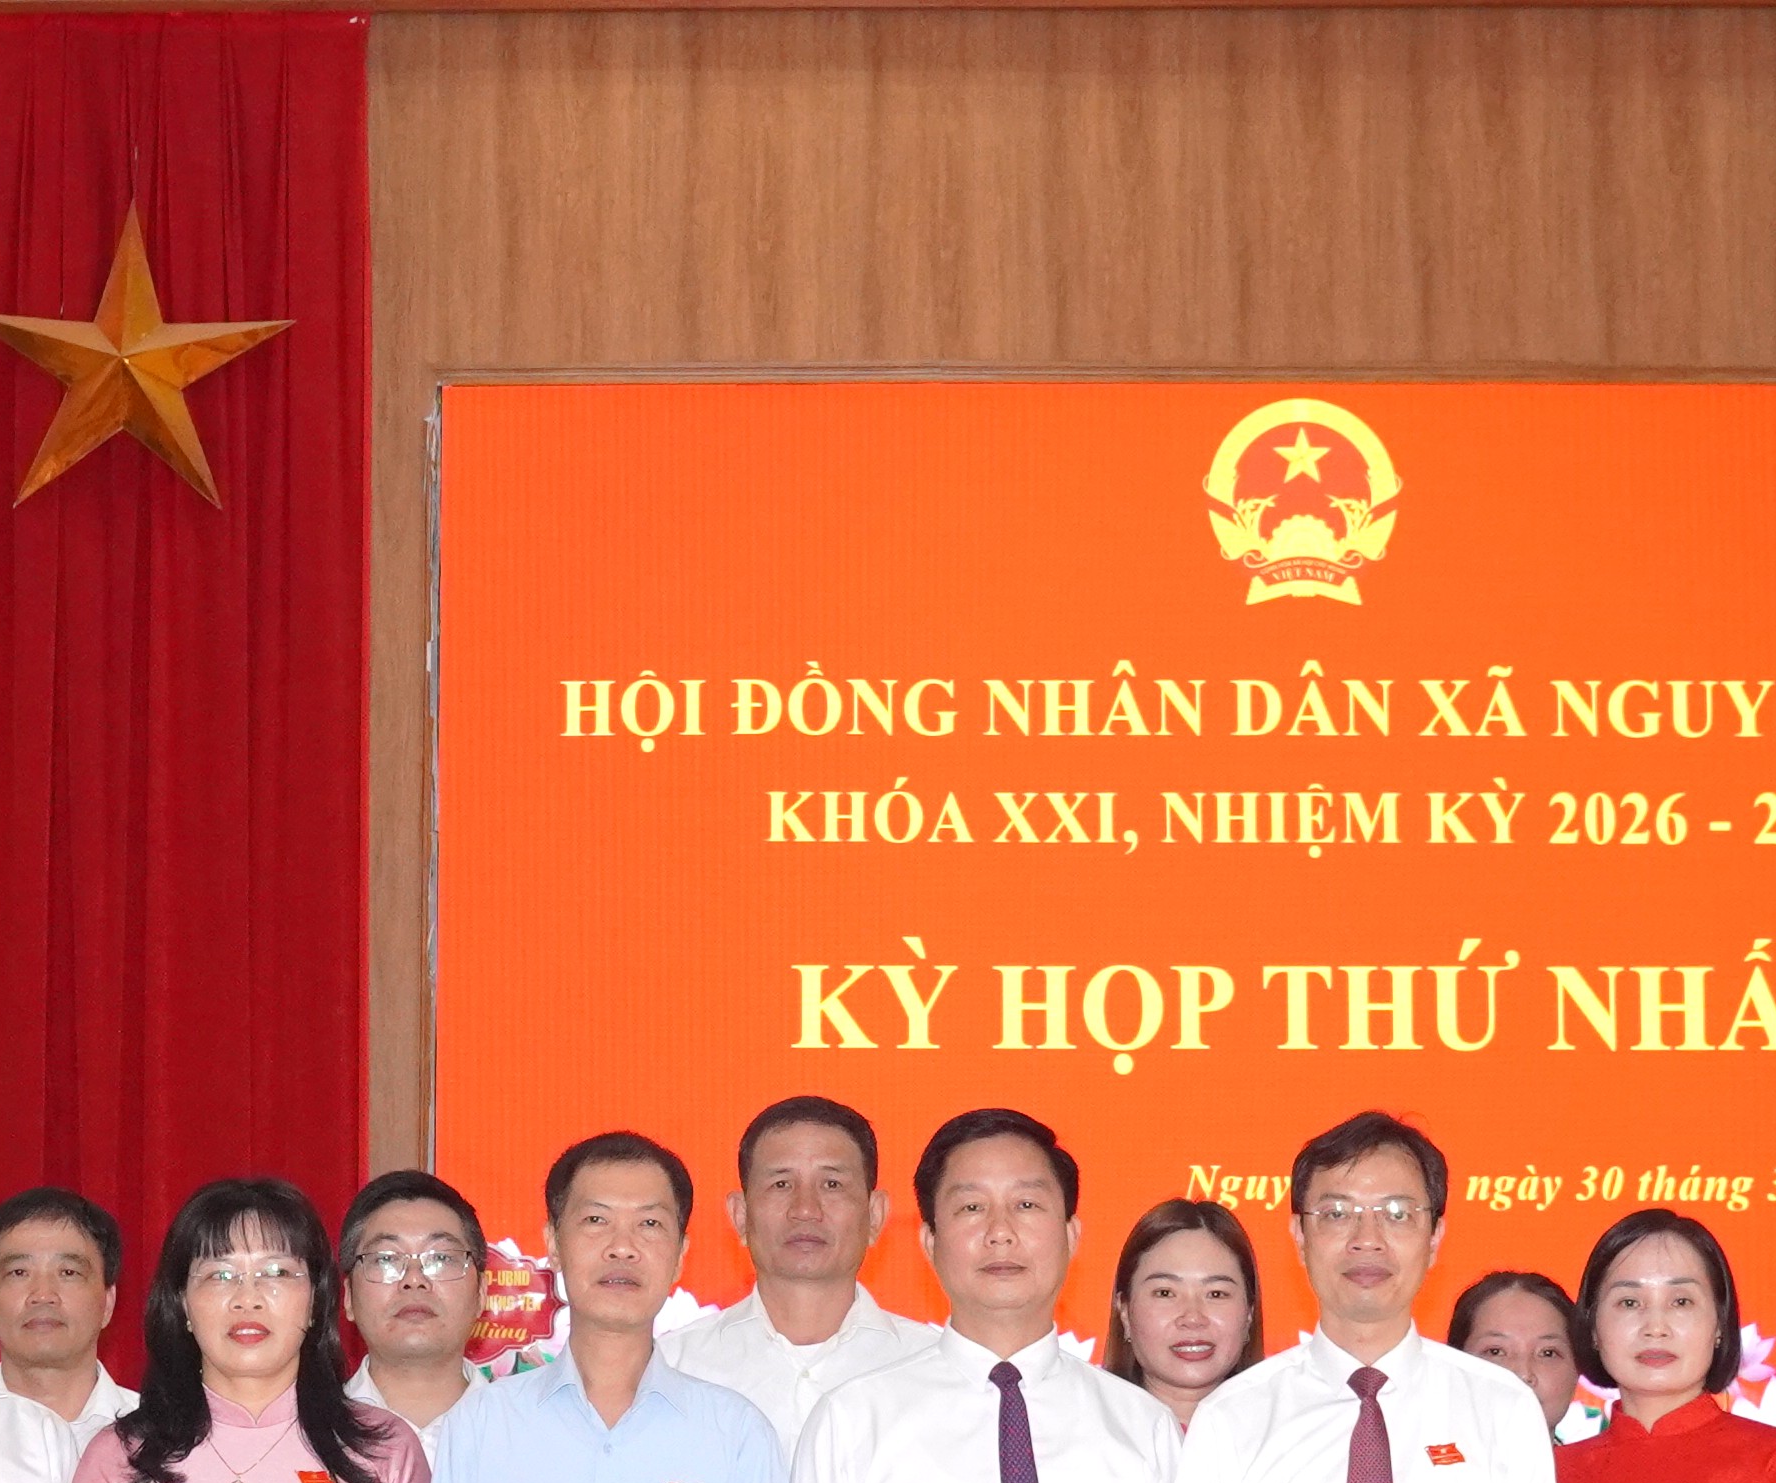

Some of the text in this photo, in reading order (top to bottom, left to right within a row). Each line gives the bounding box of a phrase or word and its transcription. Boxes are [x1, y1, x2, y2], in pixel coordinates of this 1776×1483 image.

[1305, 567, 1335, 582] NAM
[559, 669, 706, 753] HỘI
[730, 660, 958, 737] ĐỒNG
[982, 659, 1207, 737] NHÂN
[1229, 659, 1394, 737] DÂN
[1418, 664, 1528, 737] XÃ
[766, 776, 975, 844] KHÓA
[992, 791, 1139, 855] XXI,
[1160, 782, 1401, 859] NHIỆM
[1426, 774, 1526, 844] KỲ
[1548, 791, 1688, 846] 2026
[1708, 820, 1732, 832] -
[790, 934, 959, 1050] KỲ
[991, 964, 1236, 1076] HỌP
[1262, 937, 1521, 1052] THỨ
[1185, 1164, 1292, 1211] Nguy
[1465, 1164, 1563, 1212] ngày
[1575, 1165, 1625, 1203] 30
[1637, 1164, 1755, 1212] tháng
